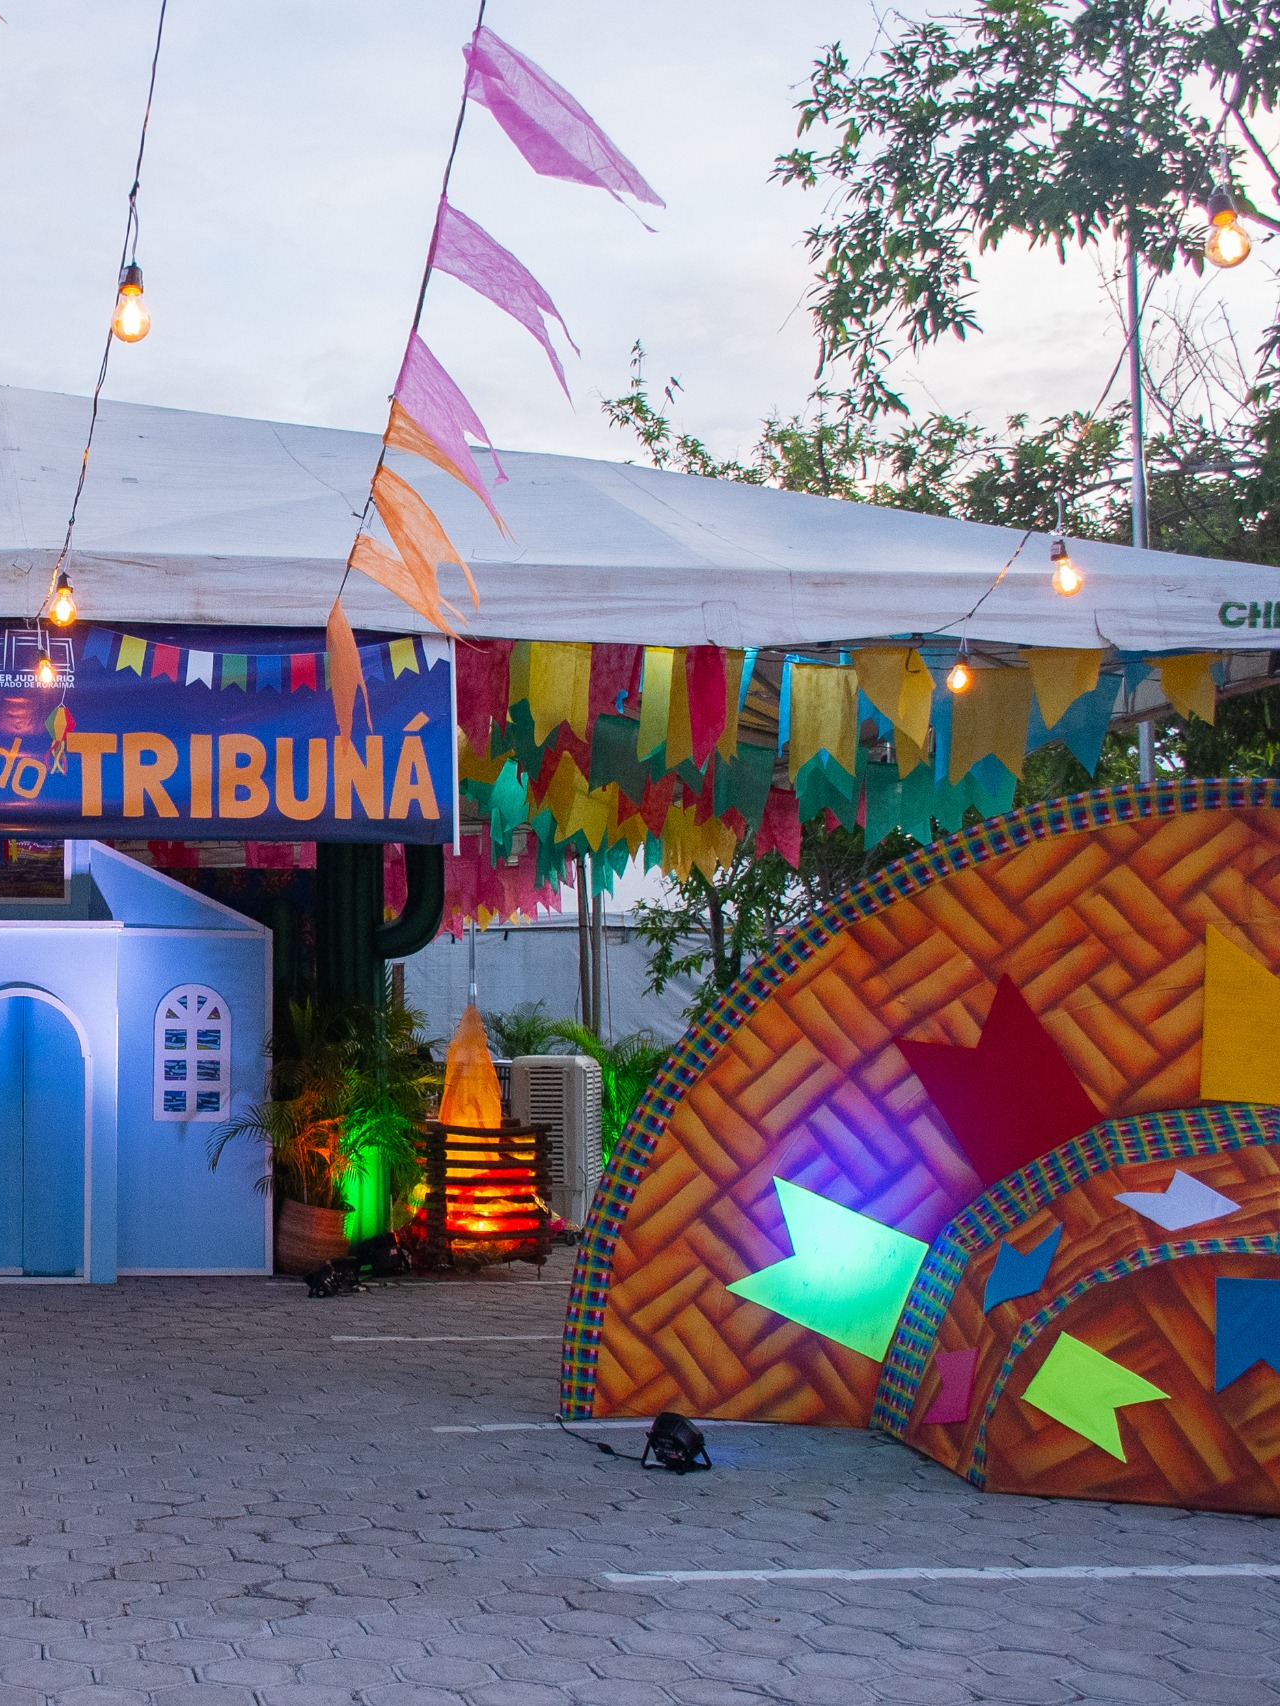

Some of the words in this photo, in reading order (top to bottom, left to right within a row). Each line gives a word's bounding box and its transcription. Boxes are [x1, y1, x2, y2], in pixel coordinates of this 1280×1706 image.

[14, 673, 75, 682] JUDIRIO
[36, 681, 75, 689] RORAIMA
[66, 711, 441, 820] TRIBUNÁ
